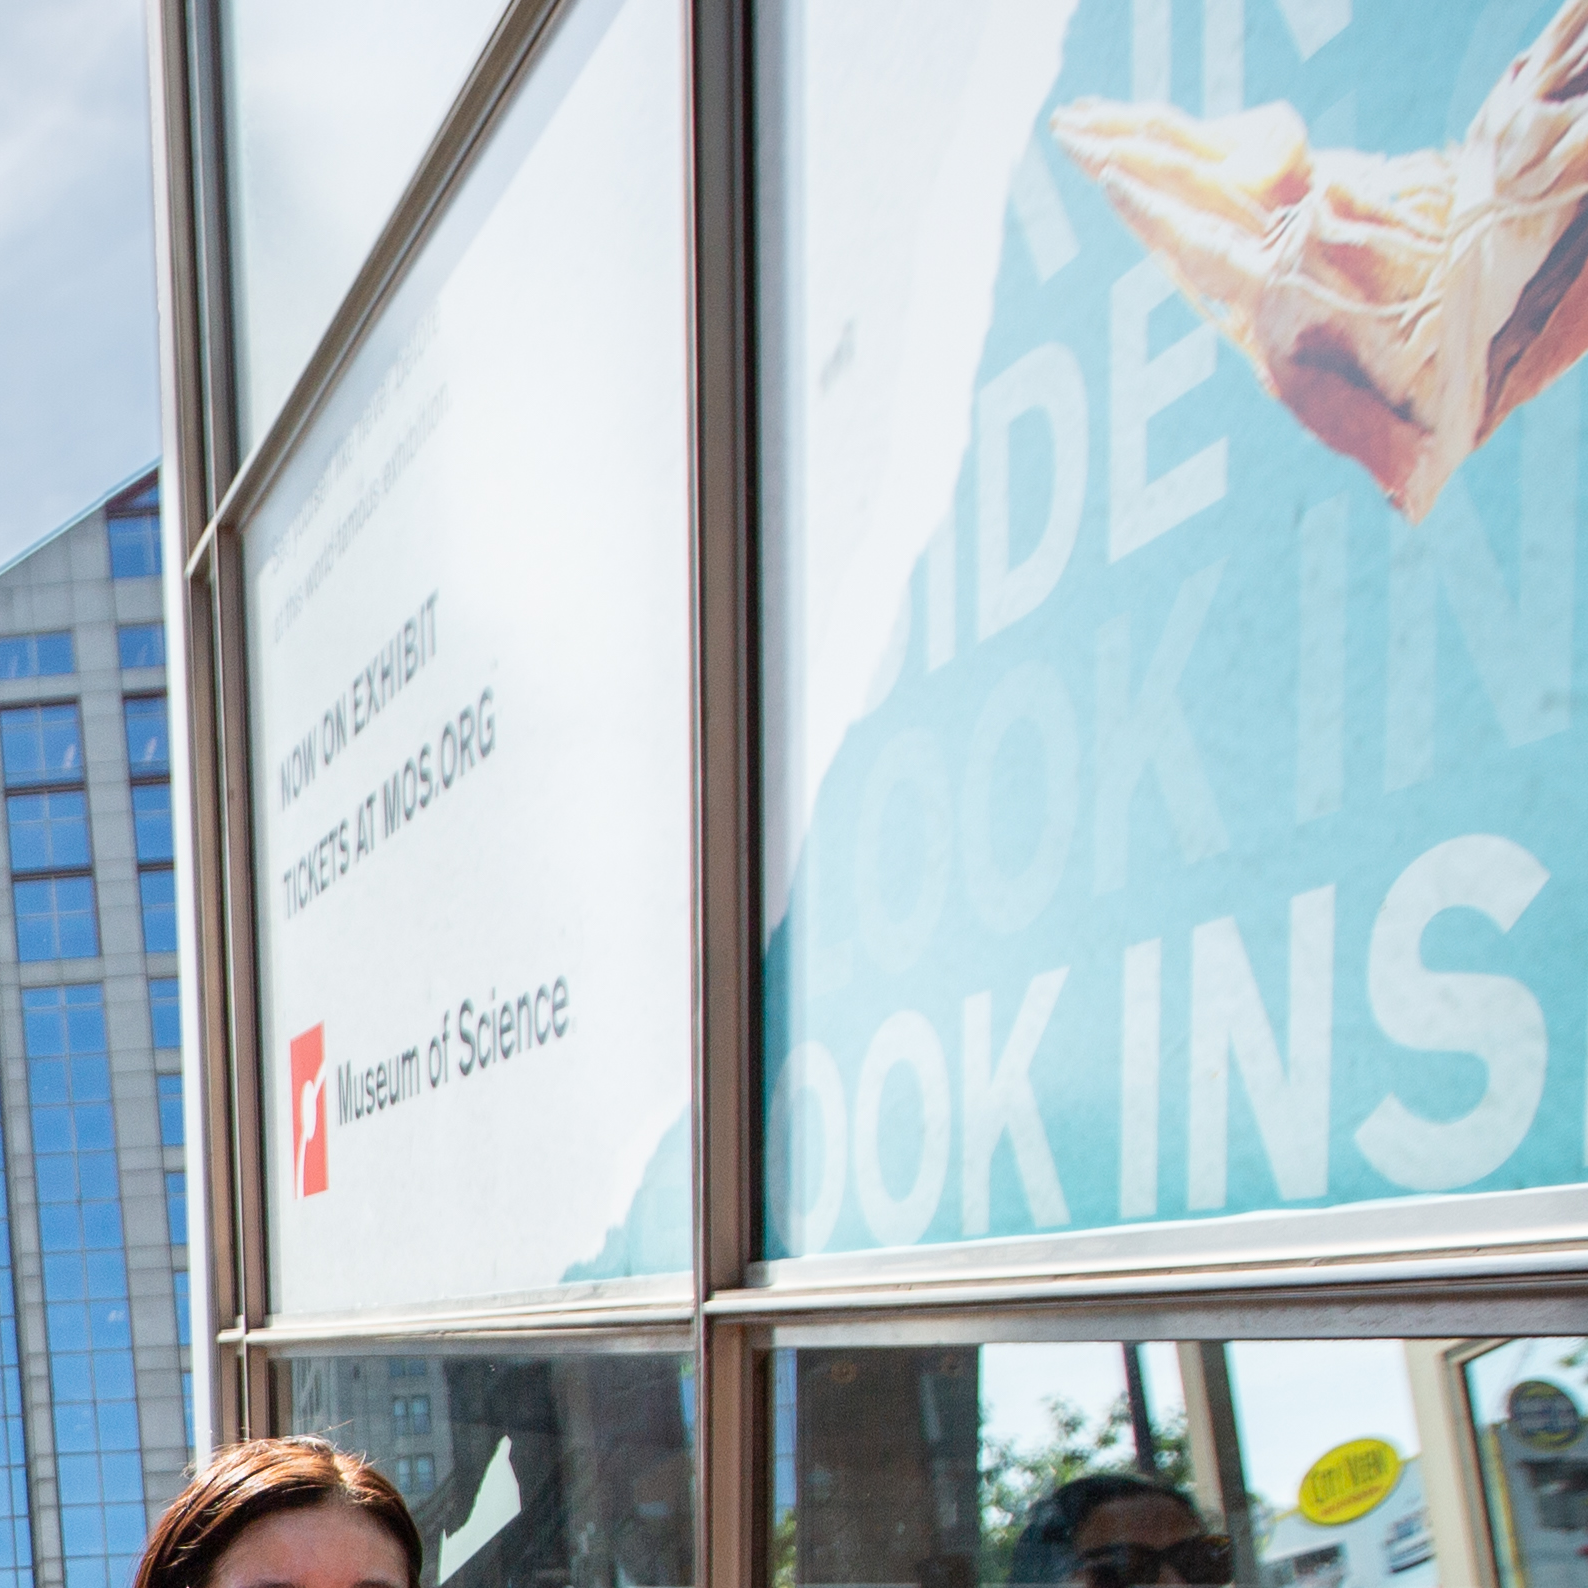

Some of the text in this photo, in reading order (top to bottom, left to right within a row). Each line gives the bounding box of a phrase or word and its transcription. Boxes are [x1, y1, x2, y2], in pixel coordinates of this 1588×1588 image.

[899, 258, 1229, 690] IDE
[280, 588, 440, 812] NOW ON EXHIBIT
[283, 684, 497, 920] TICKETS AT MOS.ORG
[336, 973, 570, 1127] Museum of Science
